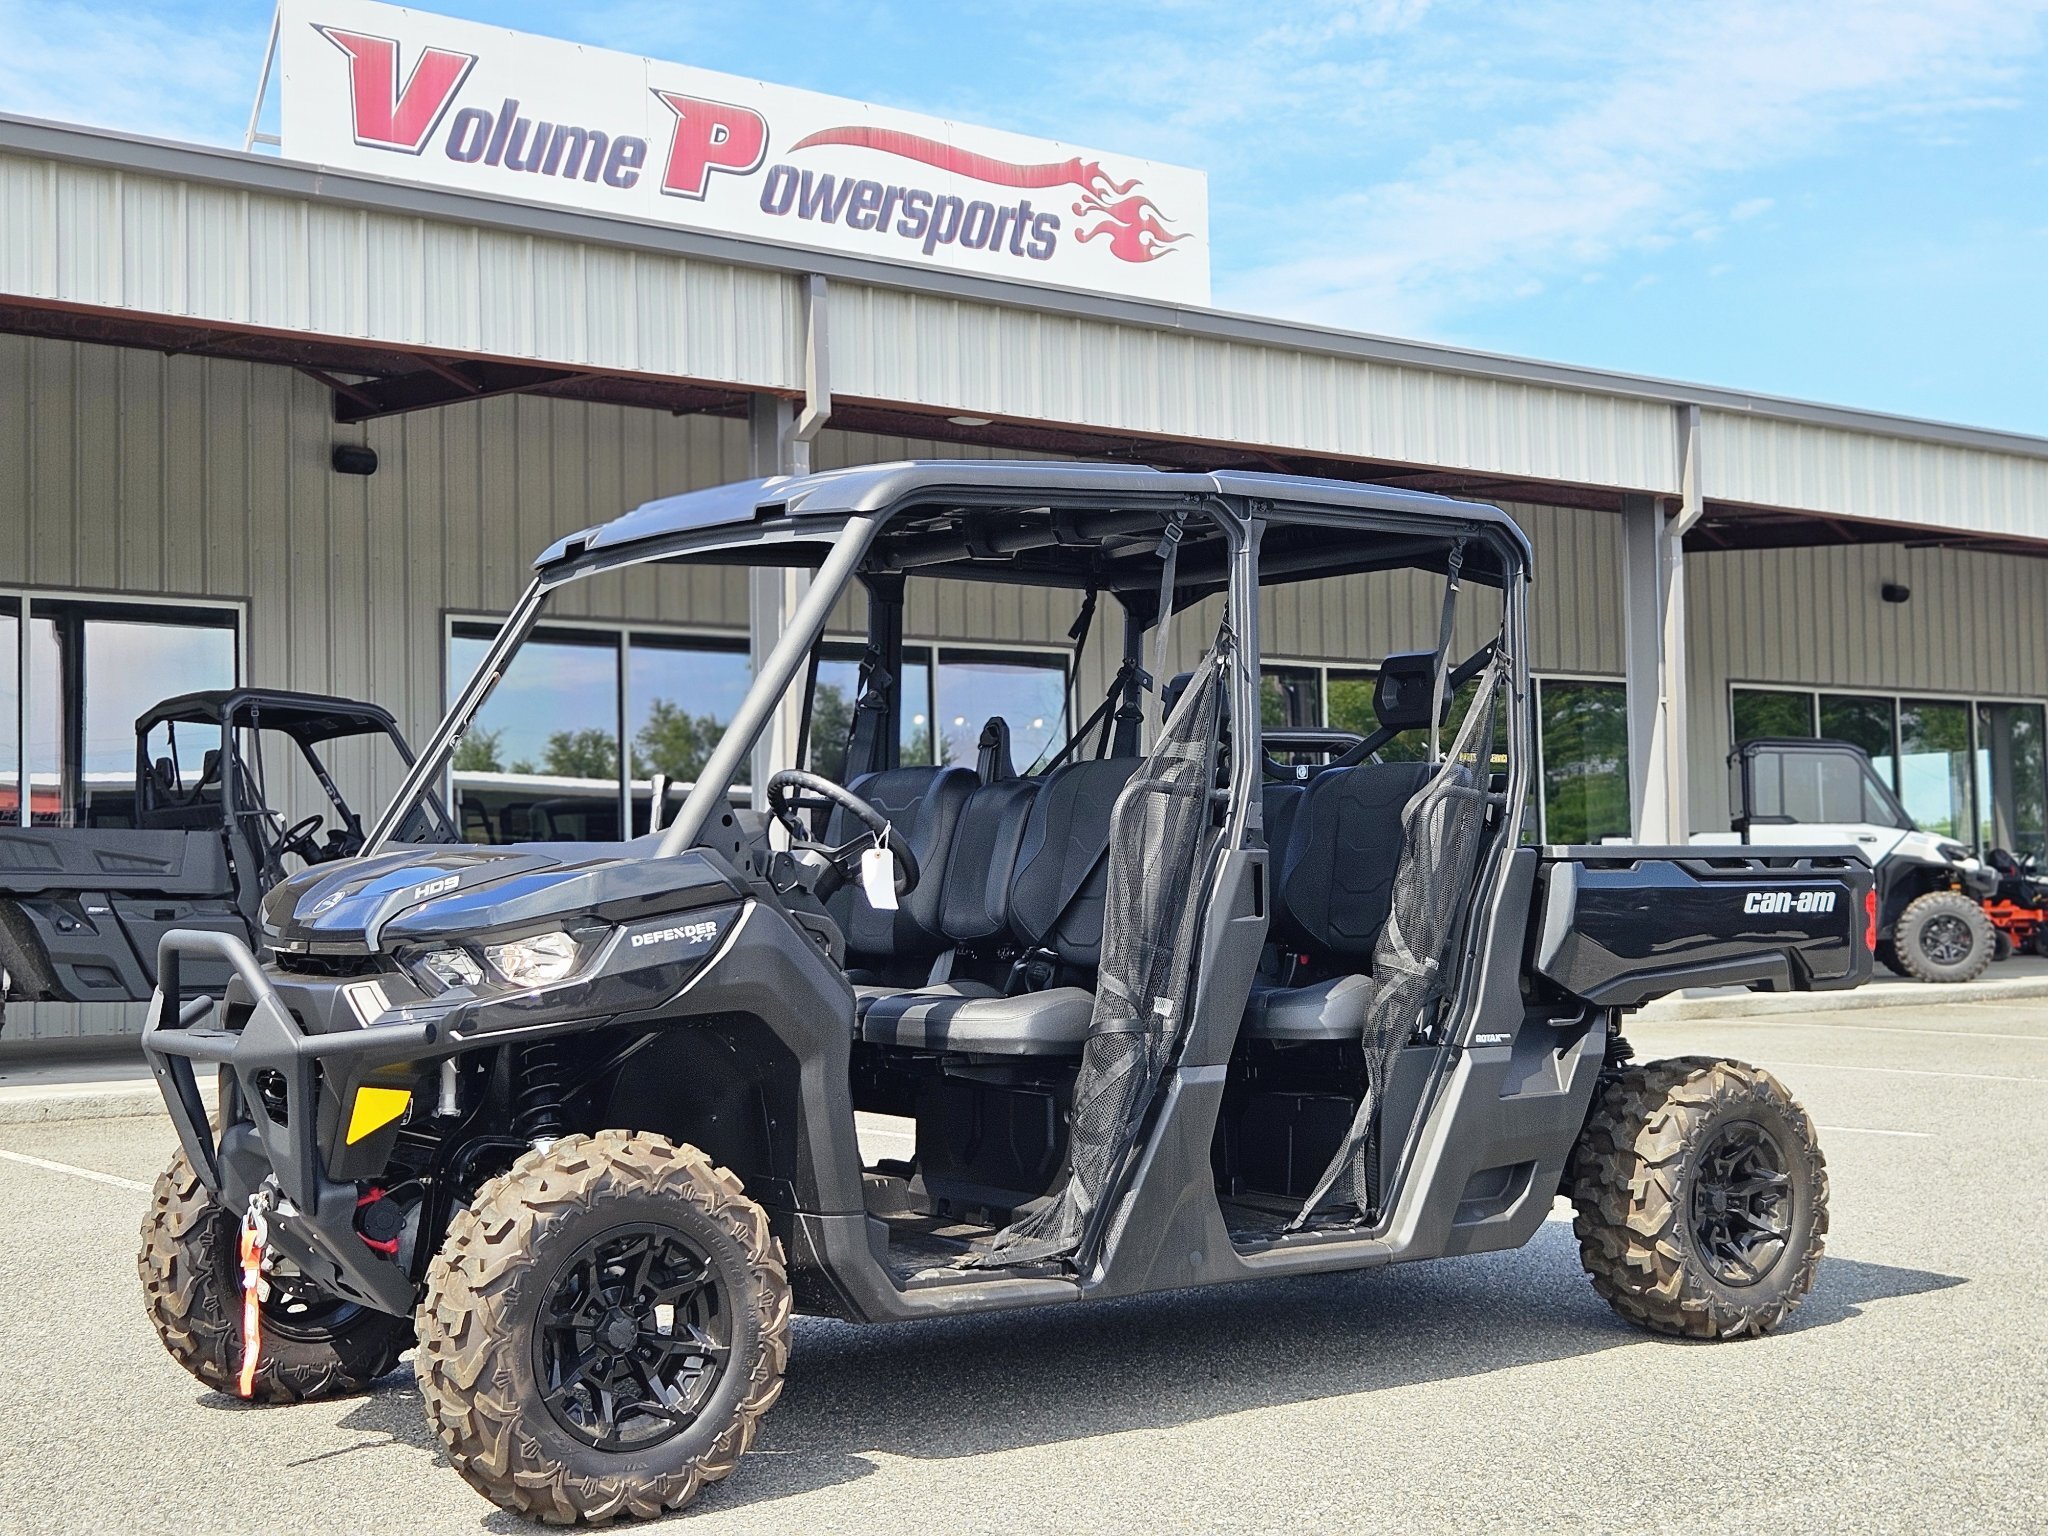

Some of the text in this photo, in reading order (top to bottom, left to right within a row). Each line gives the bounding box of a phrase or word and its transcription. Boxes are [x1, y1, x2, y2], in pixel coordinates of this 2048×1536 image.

[309, 22, 1061, 260] Volume Powersports
[414, 875, 460, 900] HD9
[1744, 891, 1836, 914] can-am
[631, 921, 717, 947] DEFENDER
[689, 932, 717, 945] XT
[1475, 1033, 1502, 1043] ROTAX
